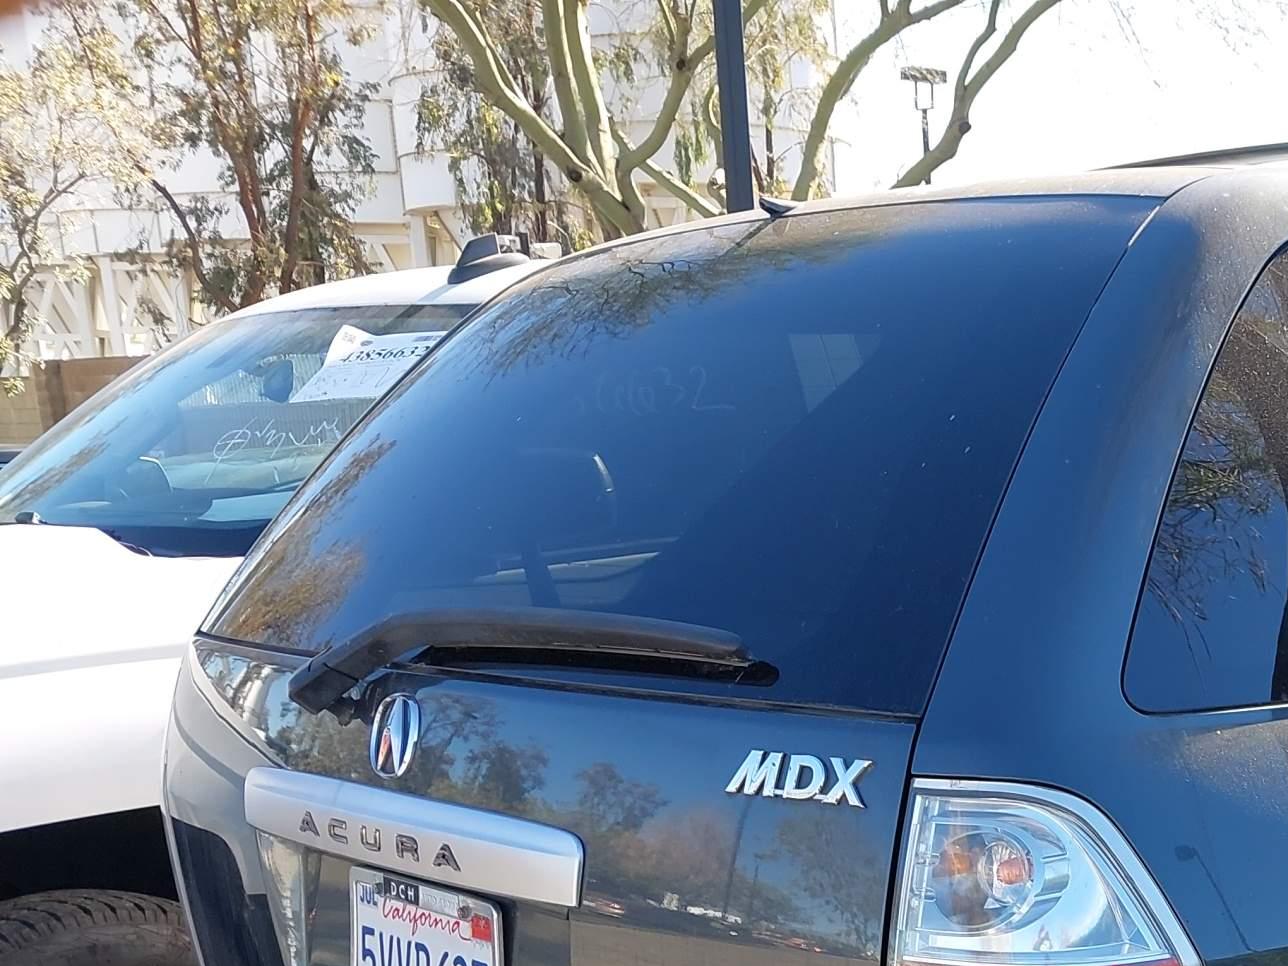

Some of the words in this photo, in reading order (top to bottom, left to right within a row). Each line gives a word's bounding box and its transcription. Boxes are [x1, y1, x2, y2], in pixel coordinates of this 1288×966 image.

[339, 345, 431, 363] 43856632
[725, 749, 873, 808] MDX
[299, 811, 461, 872] ACURA
[359, 882, 377, 906] JUL
[390, 882, 415, 902] DCH
[381, 896, 473, 942] California
